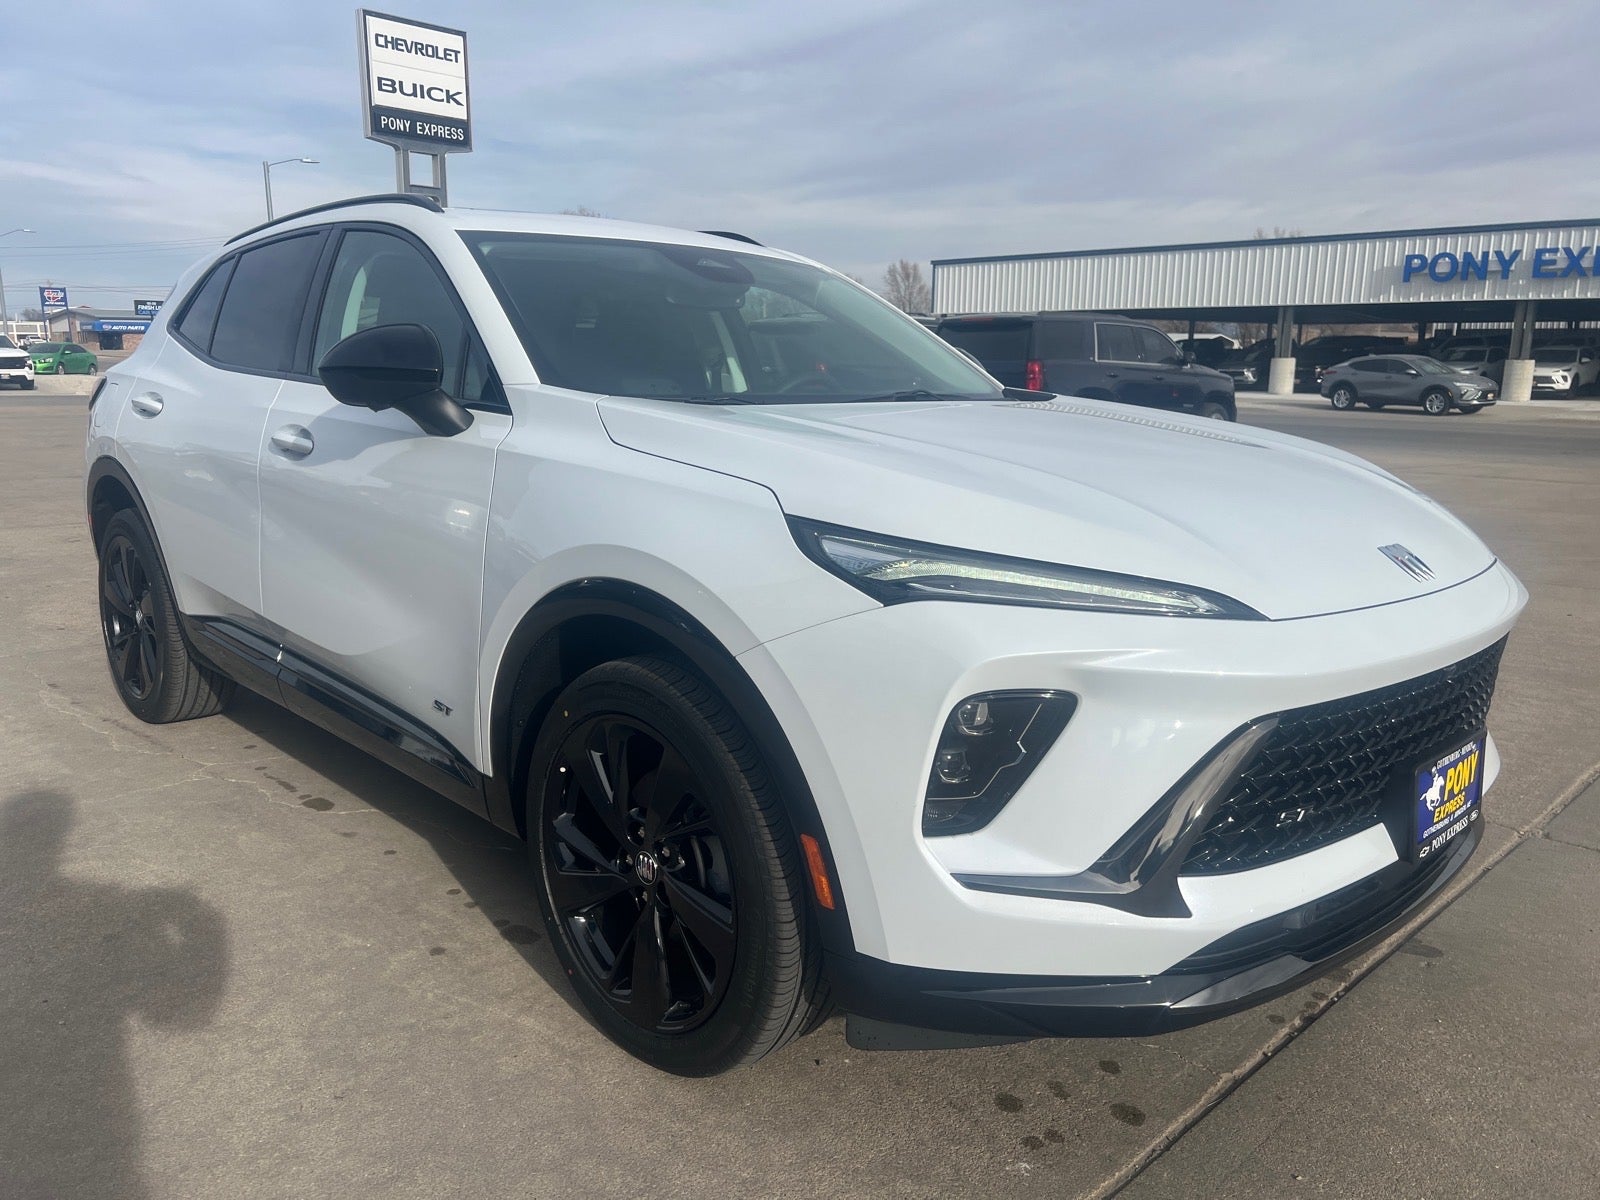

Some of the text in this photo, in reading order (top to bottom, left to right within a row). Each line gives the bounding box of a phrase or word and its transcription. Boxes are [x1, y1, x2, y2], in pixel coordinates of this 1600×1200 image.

[374, 33, 461, 63] CHEVROLET
[377, 76, 465, 107] BUICK
[381, 116, 465, 141] PONY EXPRESS
[1402, 249, 1522, 283] PONY
[432, 699, 454, 717] ST
[1444, 750, 1479, 802] PONY
[1433, 791, 1466, 823] EXPRESS
[1431, 831, 1447, 852] PONY
[1446, 815, 1469, 841] EXPRESS
